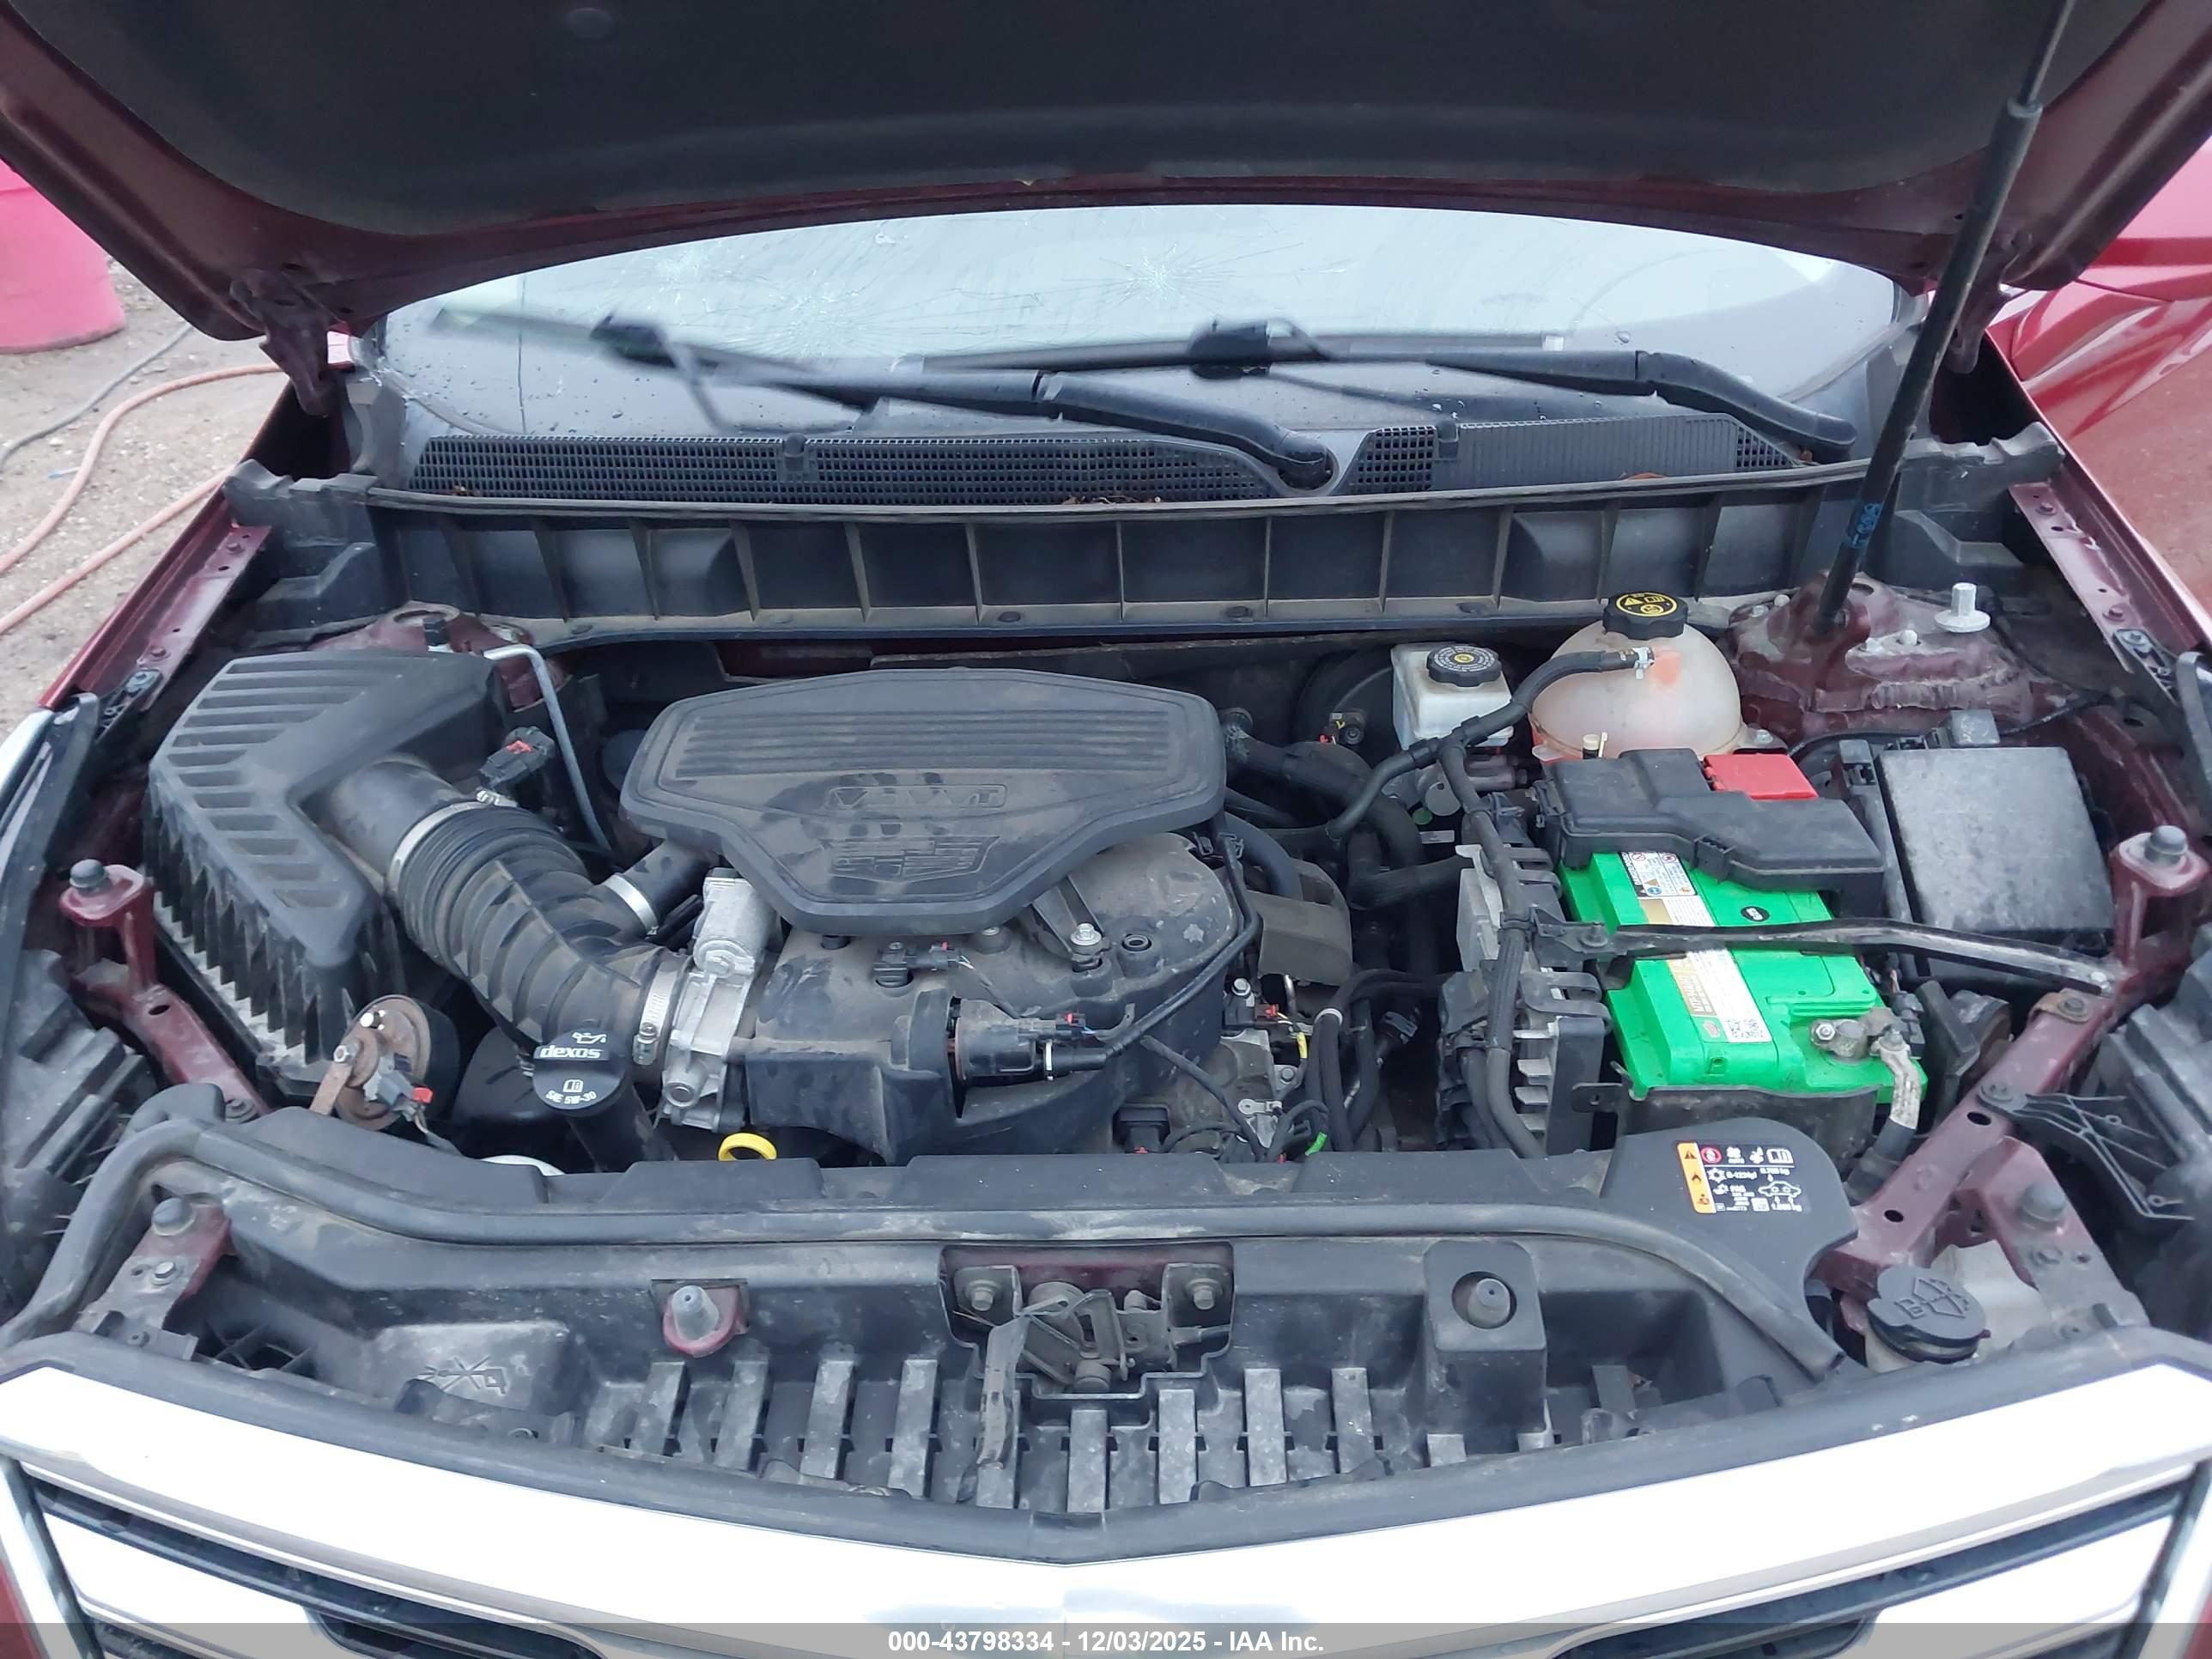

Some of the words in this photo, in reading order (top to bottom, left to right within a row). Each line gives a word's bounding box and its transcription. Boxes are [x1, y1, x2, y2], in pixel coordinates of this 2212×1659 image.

[539, 1045, 604, 1058] dexos
[545, 1091, 563, 1103] SAE
[564, 1091, 598, 1104] 5W-30
